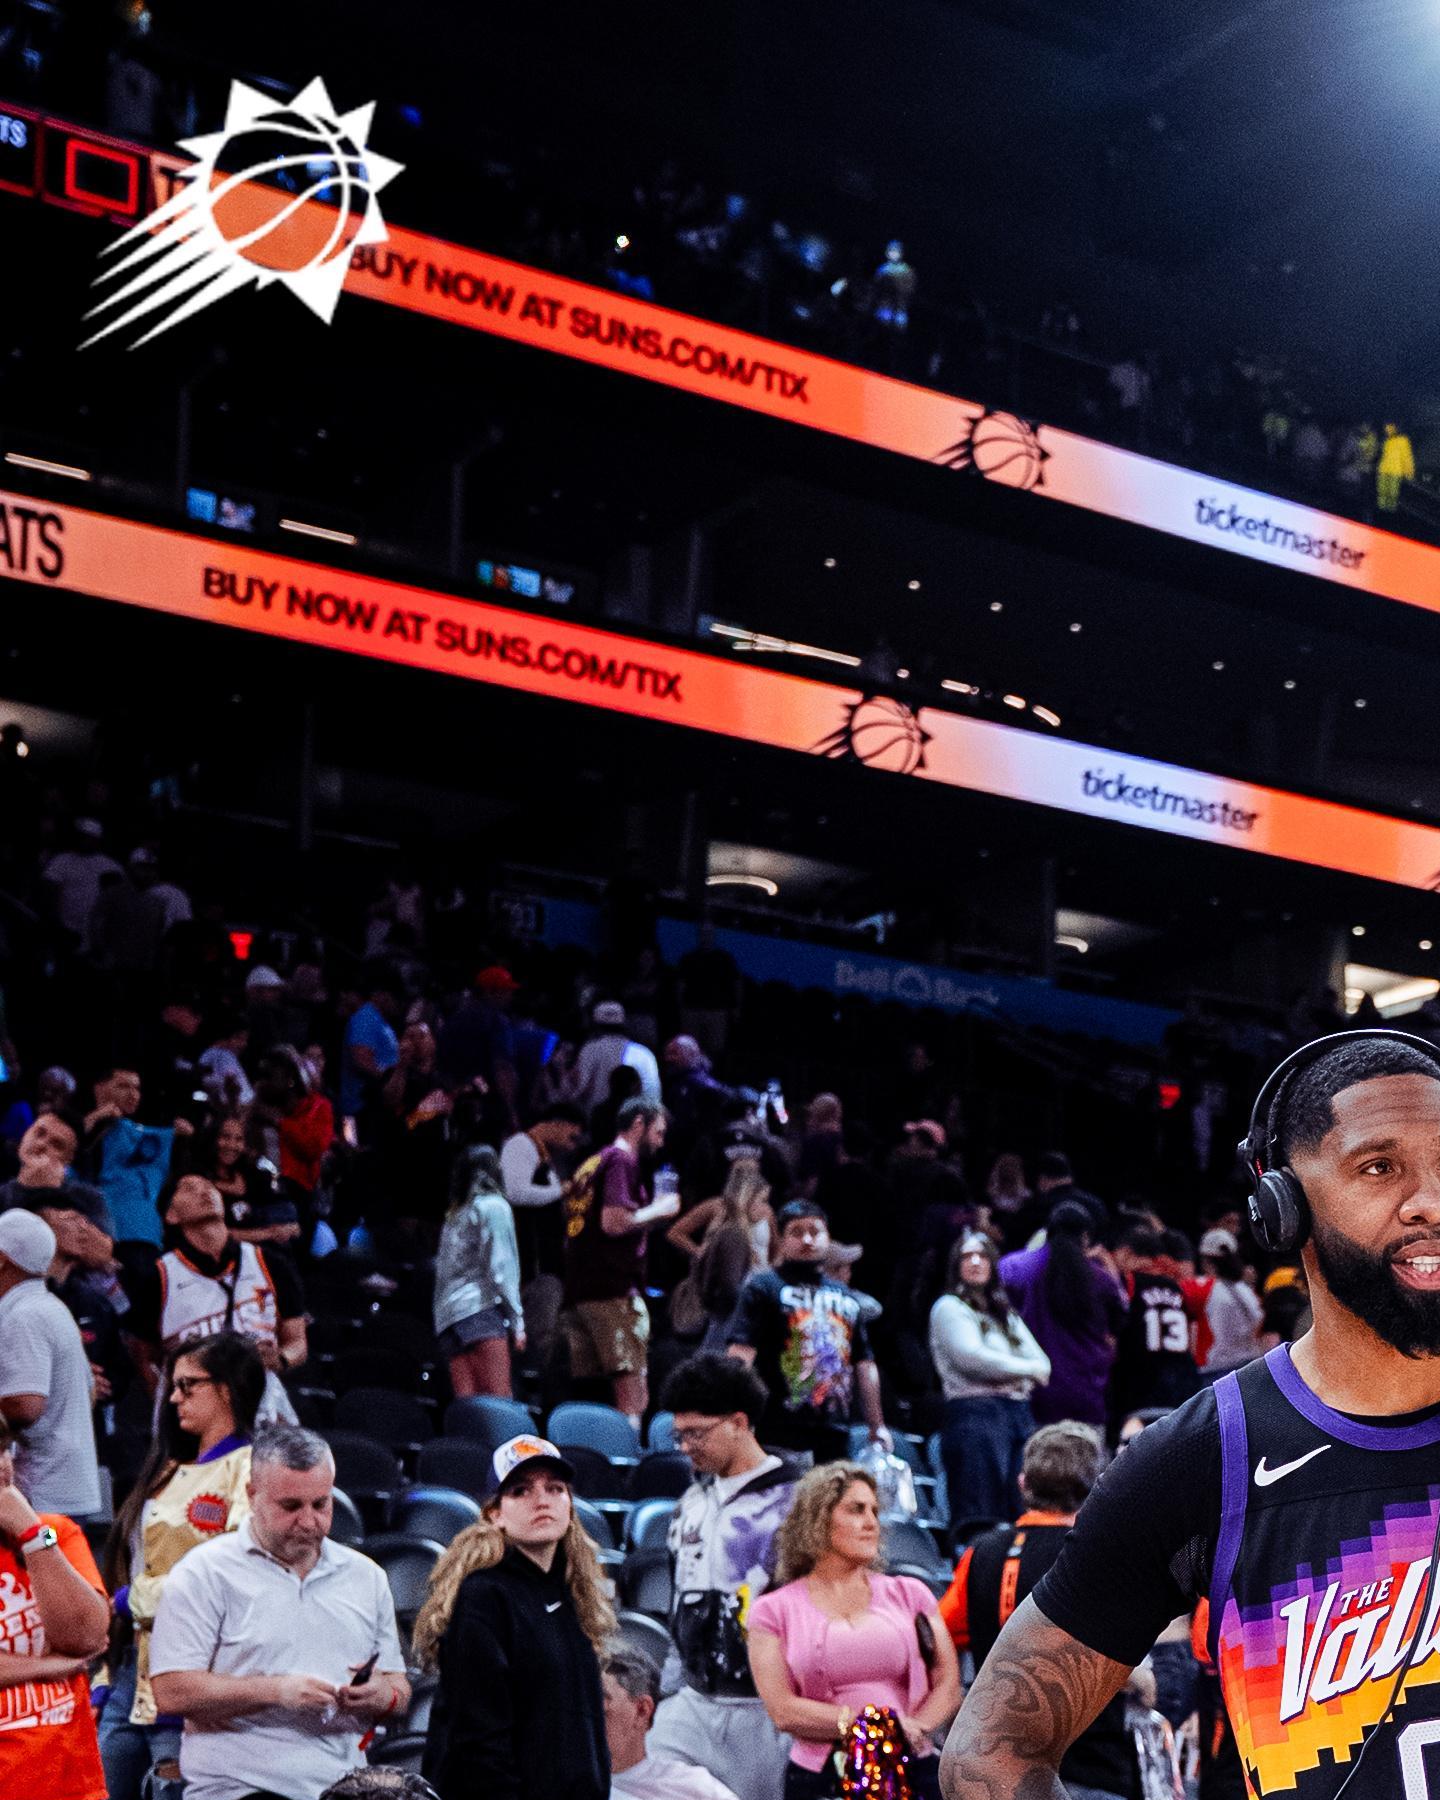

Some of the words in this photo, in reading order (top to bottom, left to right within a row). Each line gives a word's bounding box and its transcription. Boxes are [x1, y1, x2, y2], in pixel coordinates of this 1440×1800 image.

[349, 245, 418, 286] BUY
[425, 263, 515, 317] NOW
[519, 291, 567, 330] AT
[569, 306, 810, 403] SUNS.COM/TIX
[1194, 496, 1367, 571] ticketmaster
[203, 566, 279, 611] BUY
[286, 582, 378, 633] NOW
[383, 610, 428, 644] AT
[435, 618, 683, 703] SUNS.COM/TIX
[1081, 766, 1260, 833] ticketmaster
[1144, 1308, 1189, 1352] 13
[1340, 1576, 1394, 1616] THE
